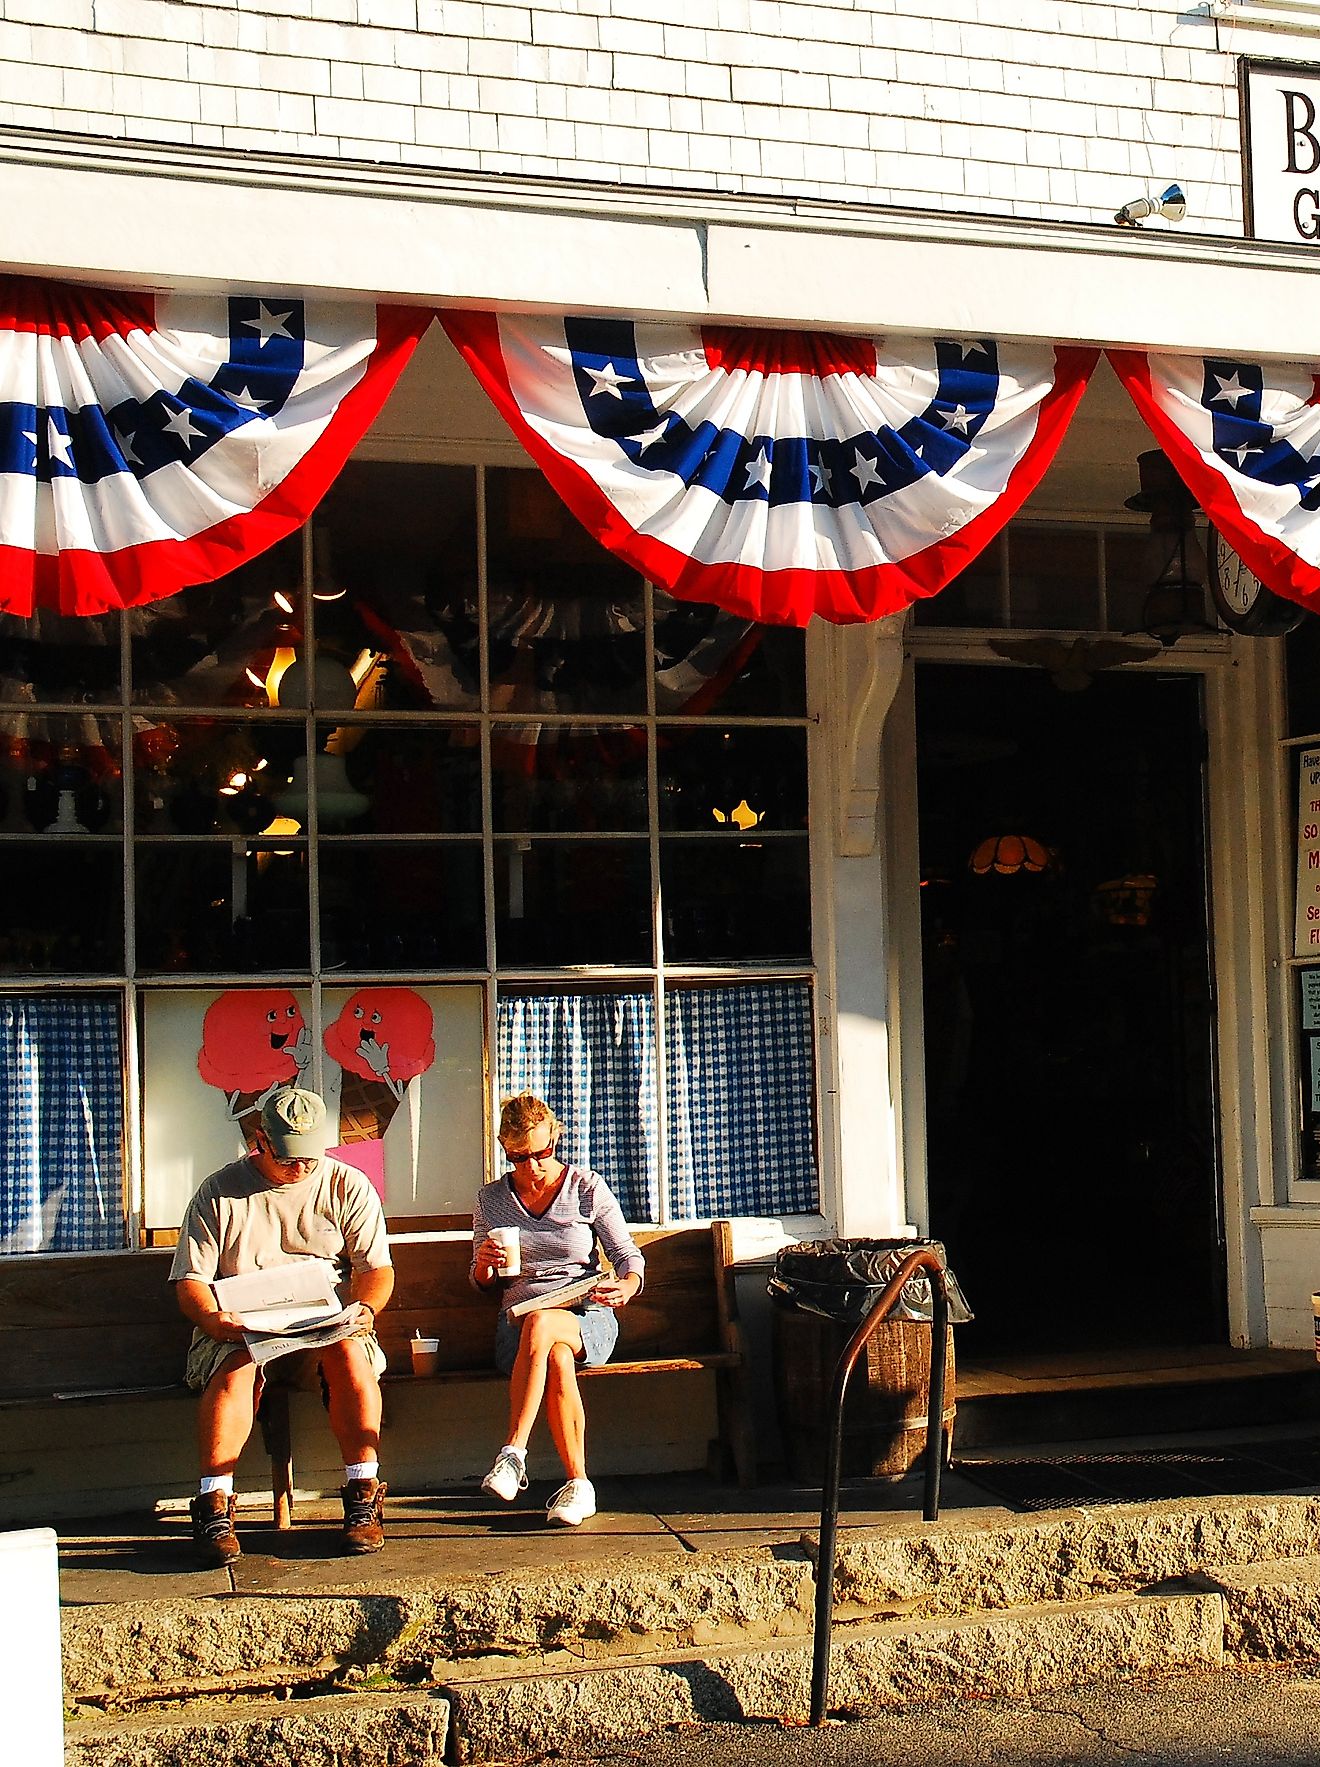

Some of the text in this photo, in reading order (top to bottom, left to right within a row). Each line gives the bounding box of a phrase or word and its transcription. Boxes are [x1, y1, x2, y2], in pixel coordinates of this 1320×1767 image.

[1224, 567, 1230, 590] 8
[1242, 584, 1249, 606] 6
[1303, 754, 1320, 768] Have
[1304, 823, 1318, 840] SO
